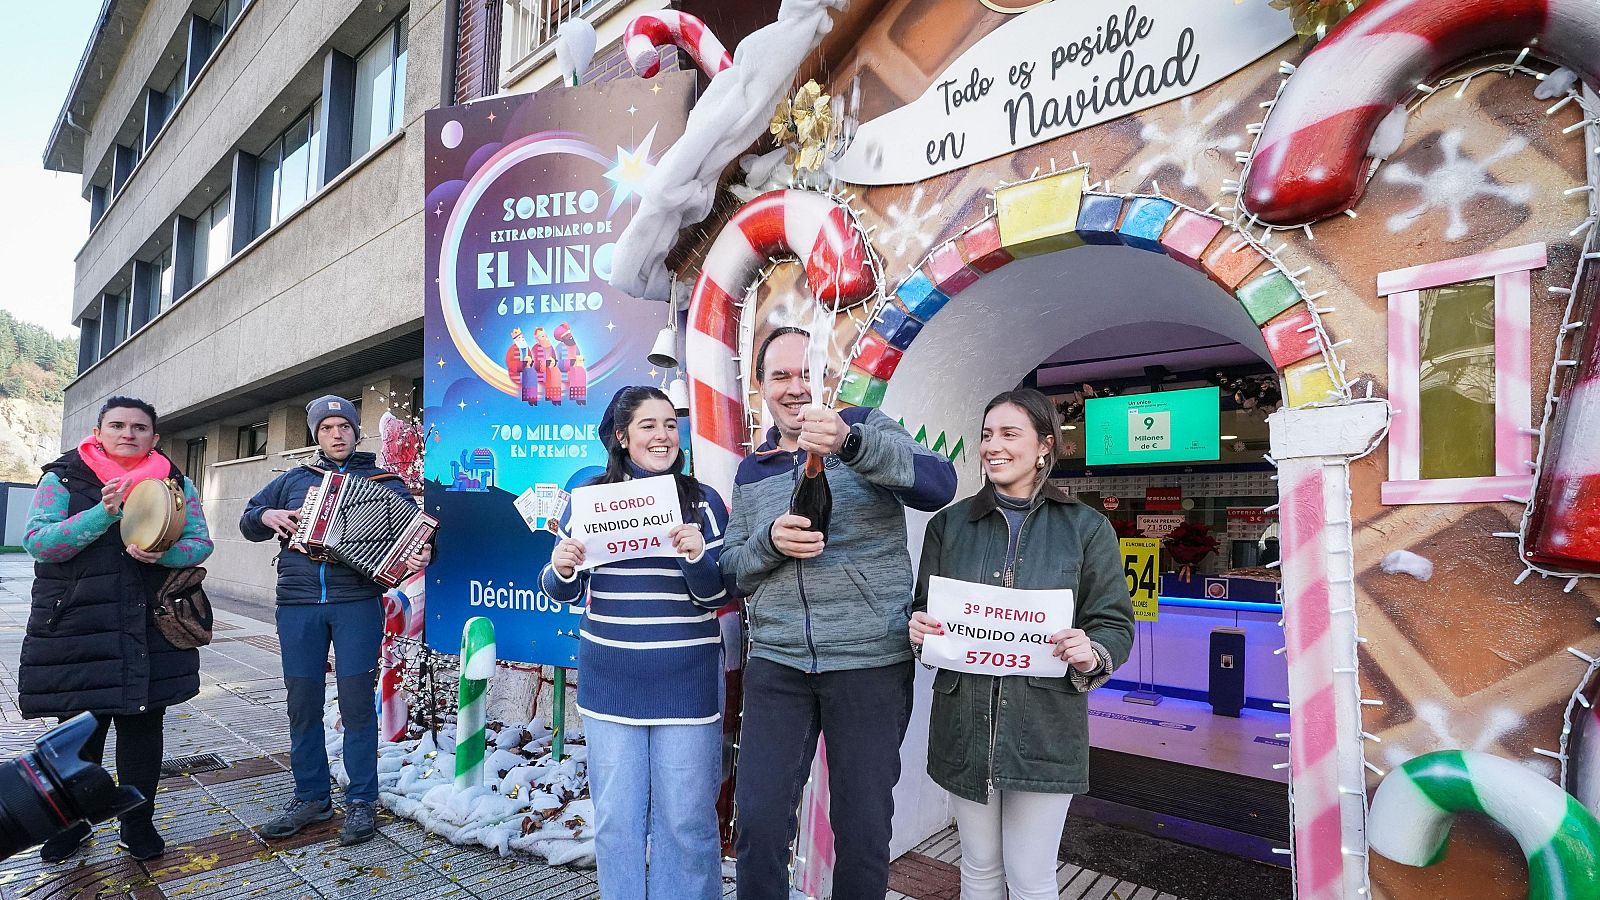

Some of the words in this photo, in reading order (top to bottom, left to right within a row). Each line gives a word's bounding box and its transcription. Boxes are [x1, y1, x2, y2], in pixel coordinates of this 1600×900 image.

[936, 66, 996, 116] Todo
[1008, 60, 1038, 87] es
[1050, 4, 1156, 81] posible
[925, 131, 967, 166] en
[1003, 27, 1201, 146] Navidad
[502, 189, 599, 222] SORTEO
[490, 223, 594, 244] EXTRAORDINARIO
[596, 220, 613, 234] DE
[477, 250, 515, 290] EL
[527, 242, 616, 286] NIÑO
[497, 297, 508, 316] 6
[513, 296, 535, 315] DE
[540, 291, 603, 313] ENERO
[490, 424, 523, 441] 700
[1143, 416, 1155, 431] 9
[510, 444, 527, 458] EN
[529, 444, 588, 458] PREMIOS
[594, 502, 608, 513] EL
[609, 495, 656, 511] GORDO
[583, 518, 639, 534] VENDIDO
[642, 509, 674, 527] AQUÍ
[606, 536, 661, 554] 97974
[1124, 555, 1157, 599] 54
[469, 579, 562, 614] Décimos
[984, 606, 1047, 624] PREMIO
[946, 622, 1015, 642] VENDIDO
[1019, 633, 1055, 645] AQU
[965, 650, 1032, 669] 57033
